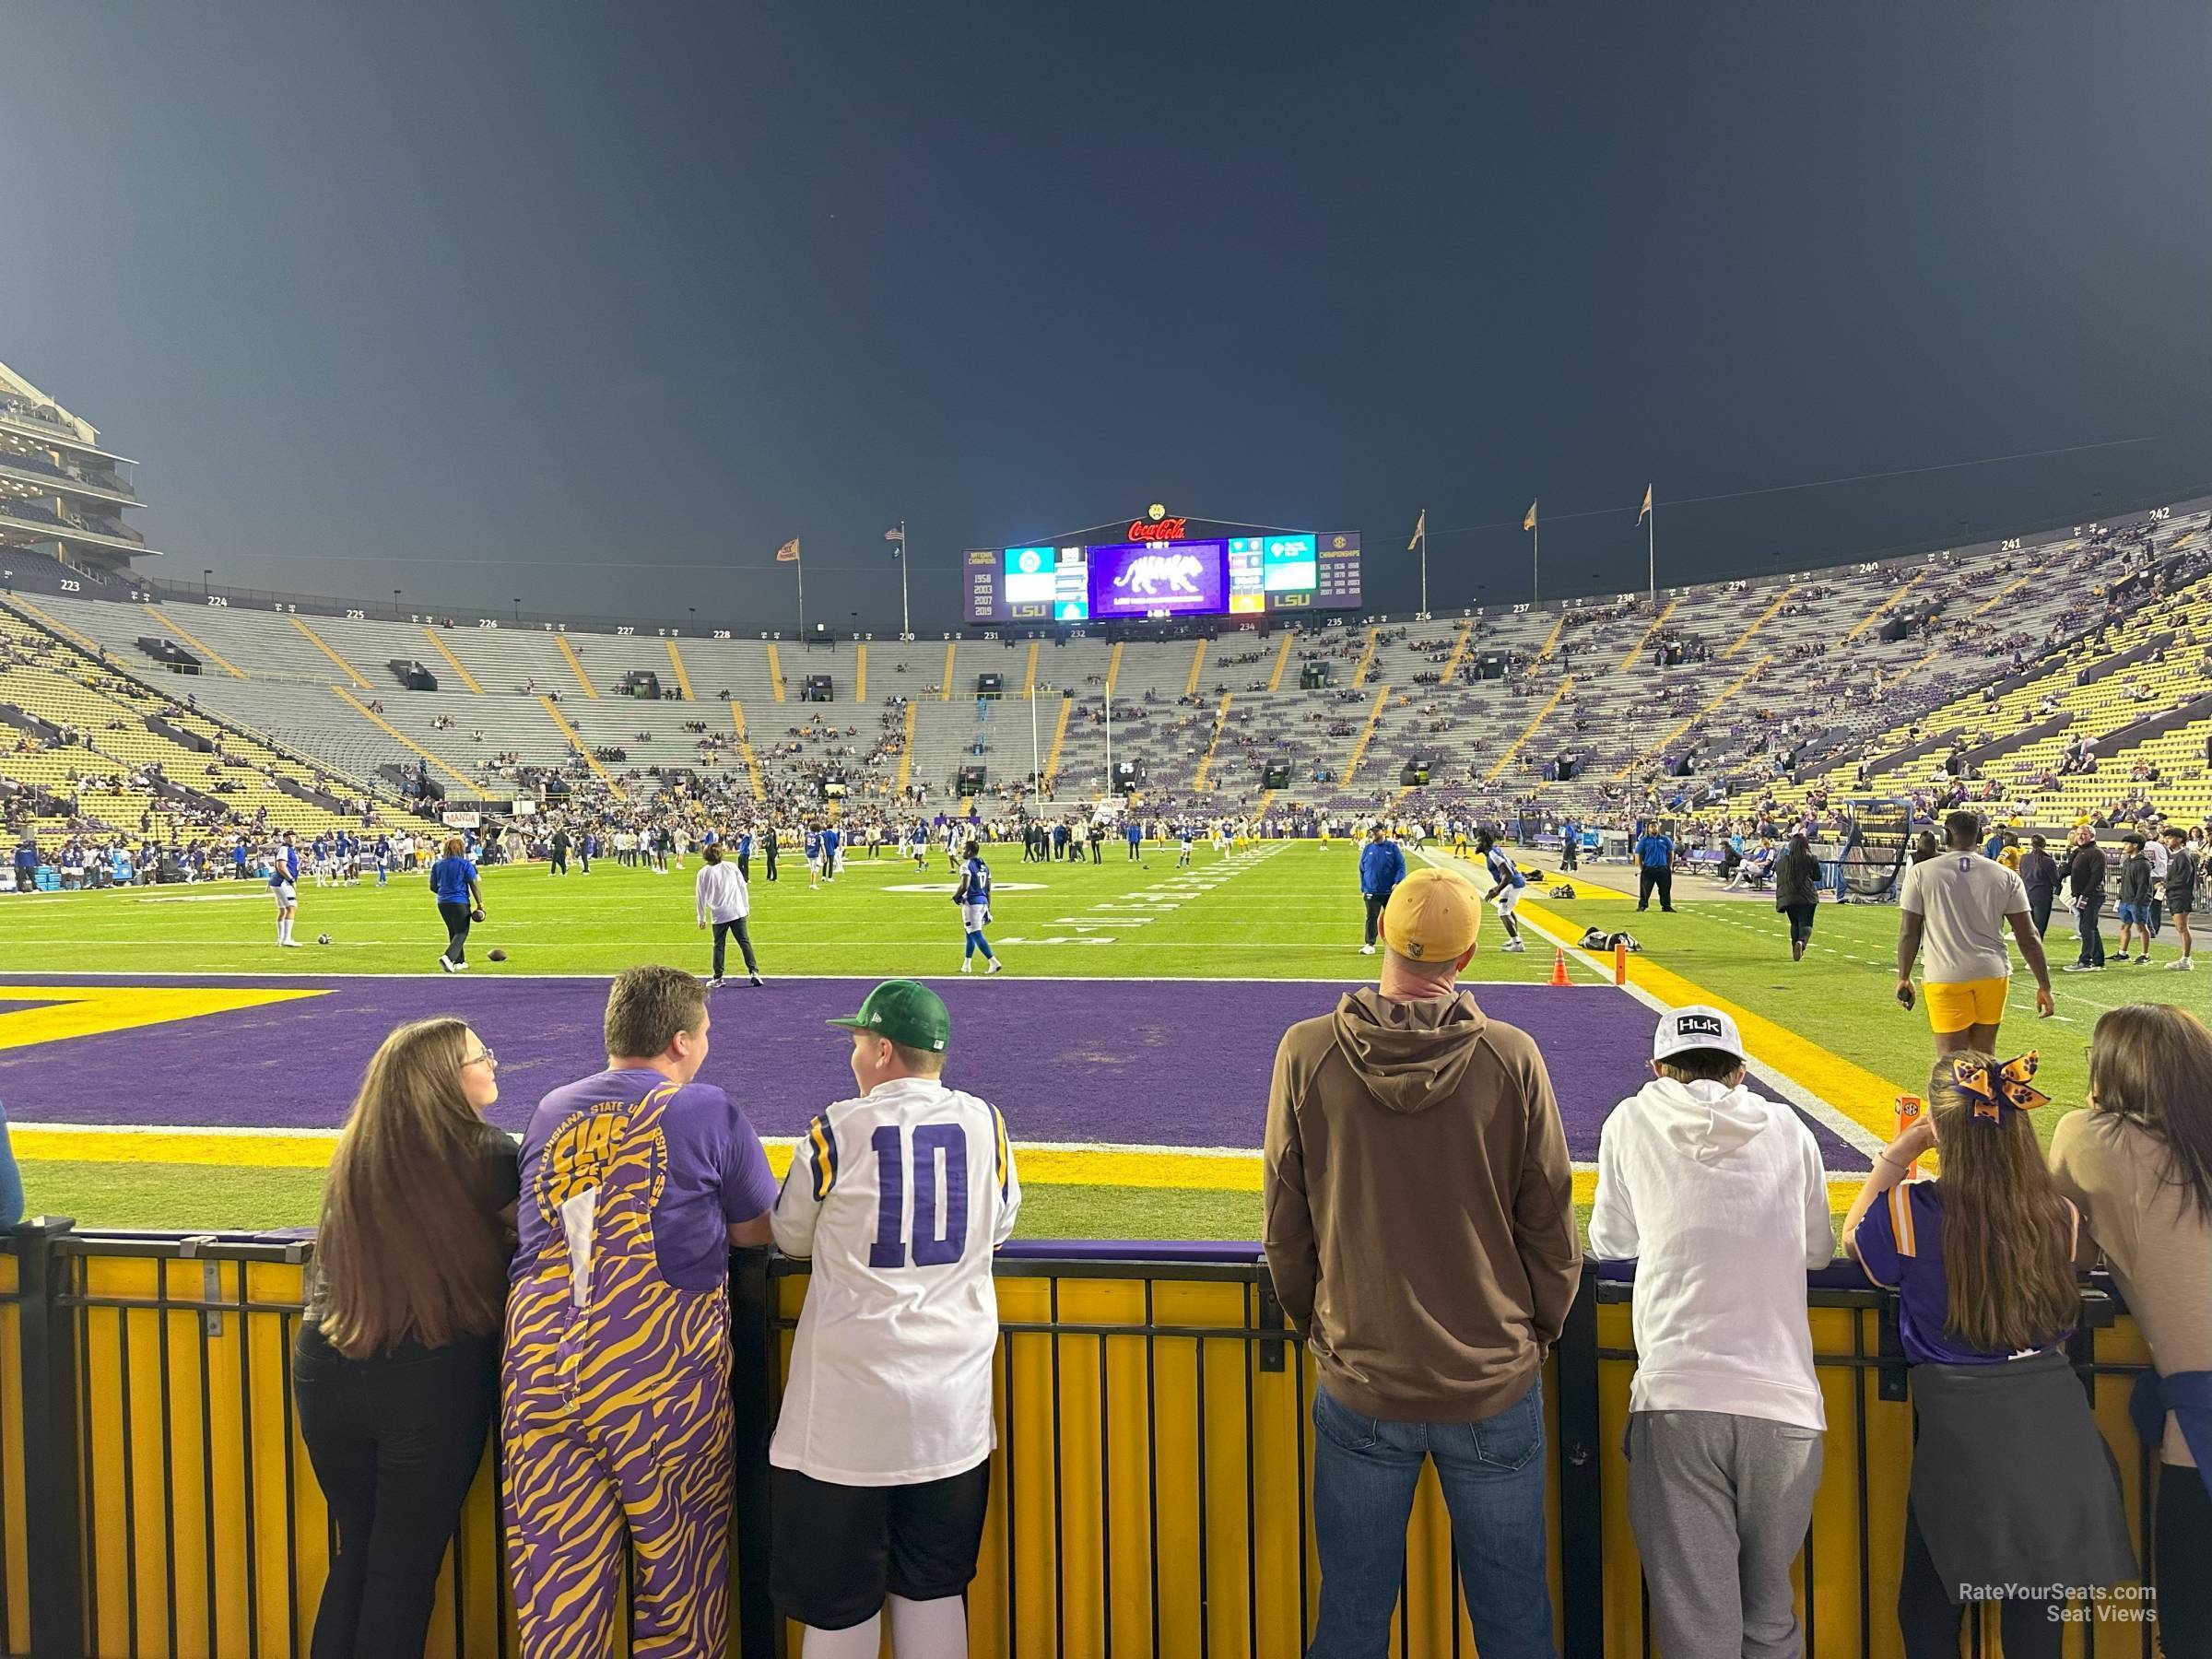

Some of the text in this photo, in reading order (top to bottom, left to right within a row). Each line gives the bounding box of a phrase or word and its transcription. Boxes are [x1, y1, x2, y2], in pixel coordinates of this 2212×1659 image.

[2149, 507, 2171, 521] 242
[1128, 519, 1187, 541] Coca-Cola
[2001, 538, 2021, 551] 241
[1859, 562, 1878, 573] 240
[974, 574, 992, 582] 1958
[60, 580, 80, 592] 223
[974, 585, 993, 594] 2003
[1728, 581, 1747, 591] 239
[207, 596, 228, 607] 224
[974, 596, 993, 605] 2007
[1275, 594, 1311, 606] LSU
[1617, 594, 1635, 604] 238
[347, 609, 365, 619] 225
[975, 606, 992, 616] 2019
[1012, 605, 1046, 618] LSU
[1512, 604, 1530, 614] 237
[1415, 612, 1432, 620] 236
[478, 619, 498, 629] 226
[1240, 623, 1255, 631] 234
[1326, 618, 1343, 627] 235
[617, 627, 635, 635] 227
[713, 630, 731, 639] 228
[983, 631, 999, 640] 231
[1120, 762, 1134, 774] 25
[447, 813, 477, 824] MANDA
[1679, 1018, 1720, 1032] Huk
[538, 1111, 584, 1171] LOUISIANA
[590, 1100, 625, 1114] STATE
[869, 1124, 968, 1267] 10
